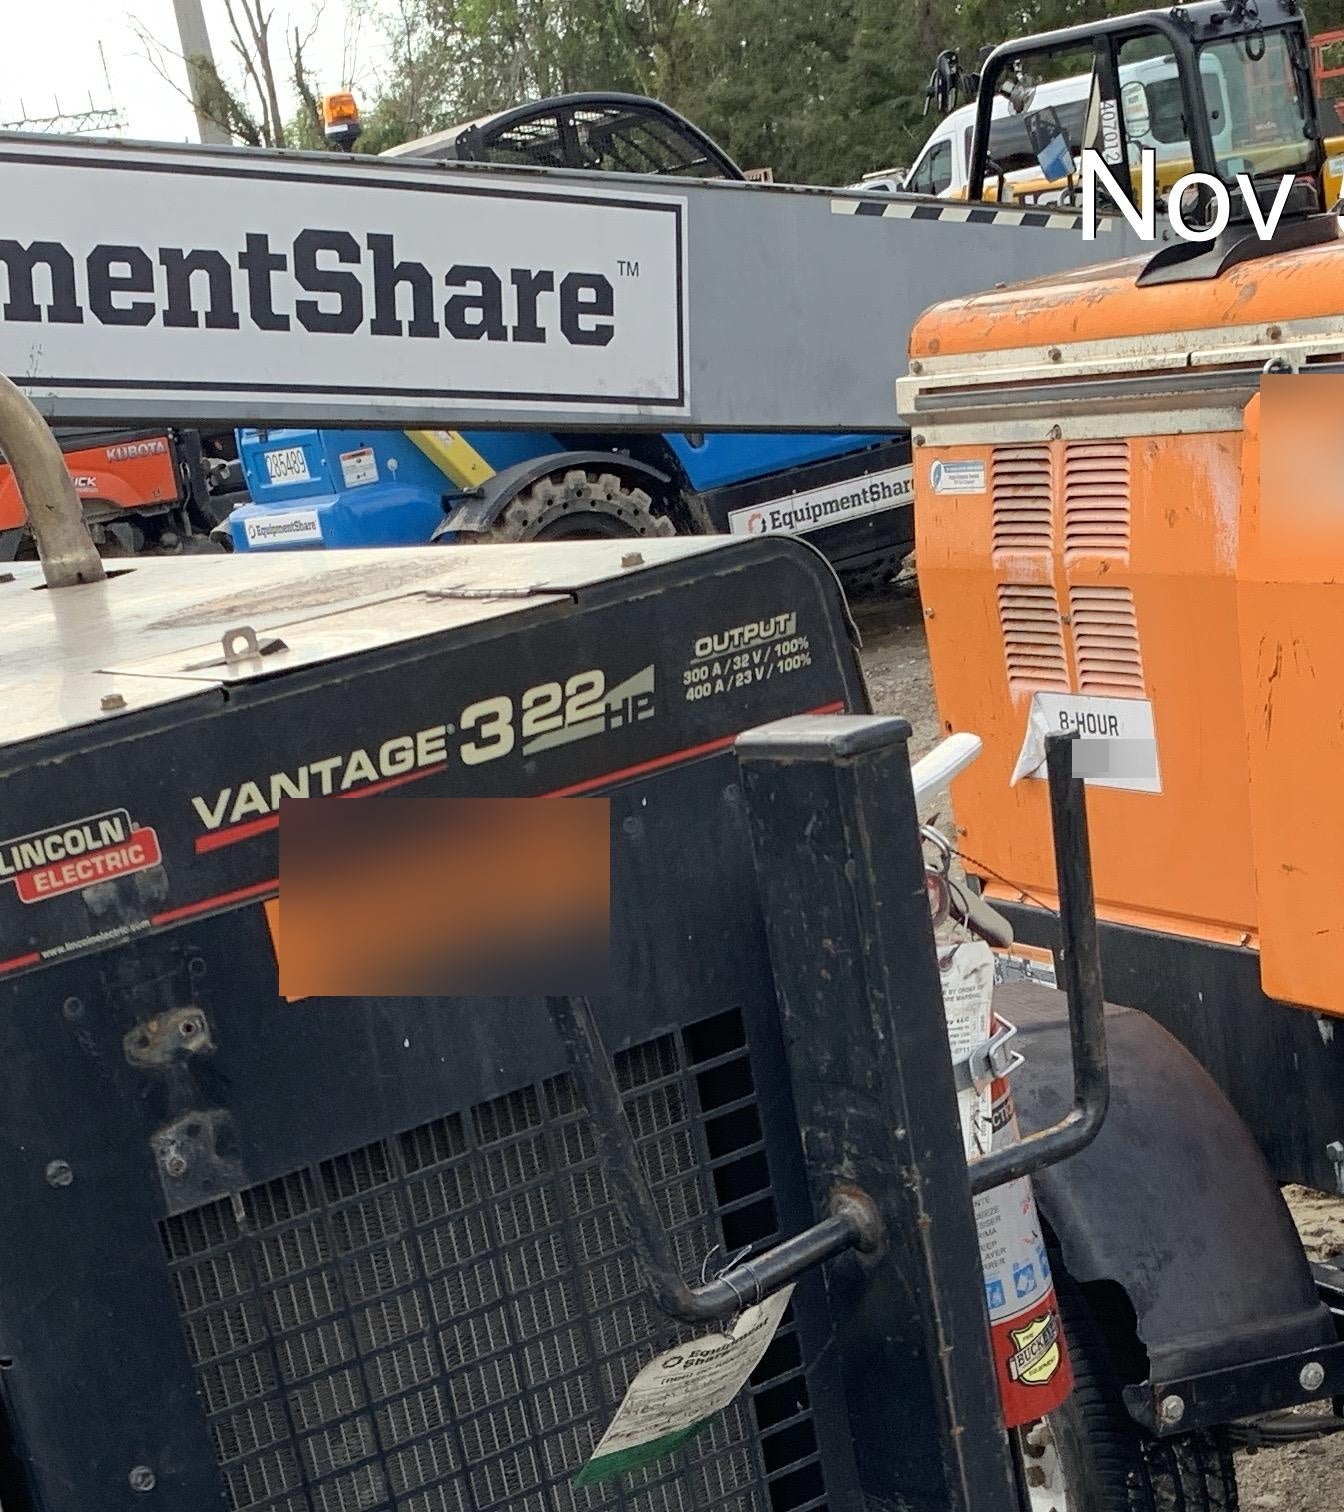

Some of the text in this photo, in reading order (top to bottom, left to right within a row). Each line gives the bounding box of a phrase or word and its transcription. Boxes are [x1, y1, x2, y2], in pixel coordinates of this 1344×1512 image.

[1101, 101, 1121, 162] 407012
[106, 442, 169, 464] KUBOTA
[267, 450, 307, 479] 285489
[256, 520, 317, 537] EquipmentShare
[694, 612, 791, 658] OUTPUT
[683, 665, 709, 686] 300
[712, 662, 722, 677] A
[733, 653, 750, 671] 32
[752, 649, 762, 665] V
[774, 635, 809, 657] 100%
[686, 683, 712, 702] 400
[714, 679, 725, 694] A
[735, 670, 752, 688] 23
[755, 666, 765, 681] V
[777, 651, 812, 674] 100%
[1059, 710, 1120, 737] 8-HOUR
[191, 723, 449, 830] VANTAGE
[460, 668, 606, 766] 322
[32, 844, 146, 893] ELECTRIC
[1016, 1321, 1057, 1367] BUCKEY
